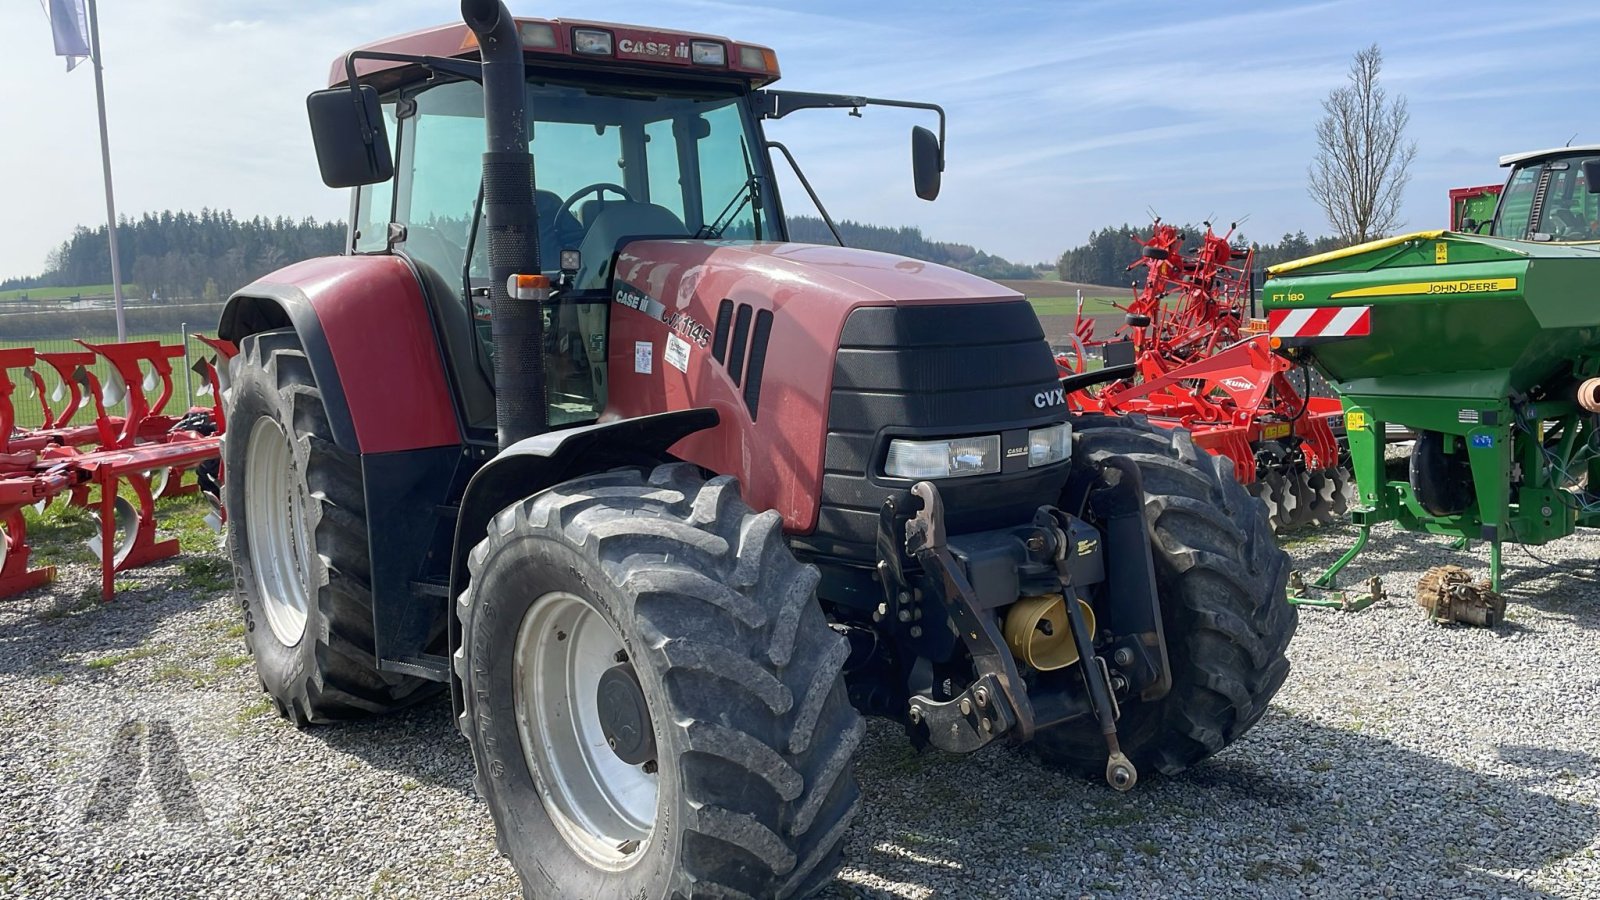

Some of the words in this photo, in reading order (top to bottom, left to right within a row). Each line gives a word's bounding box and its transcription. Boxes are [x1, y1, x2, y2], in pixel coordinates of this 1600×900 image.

[619, 39, 671, 56] CASE
[1427, 283, 1457, 293] JOHN
[1460, 282, 1498, 291] DEERE
[616, 290, 640, 309] CASE
[1273, 294, 1285, 302] FT
[1287, 293, 1304, 301] 180
[1225, 379, 1251, 389] KUHN
[1034, 388, 1065, 408] CVX
